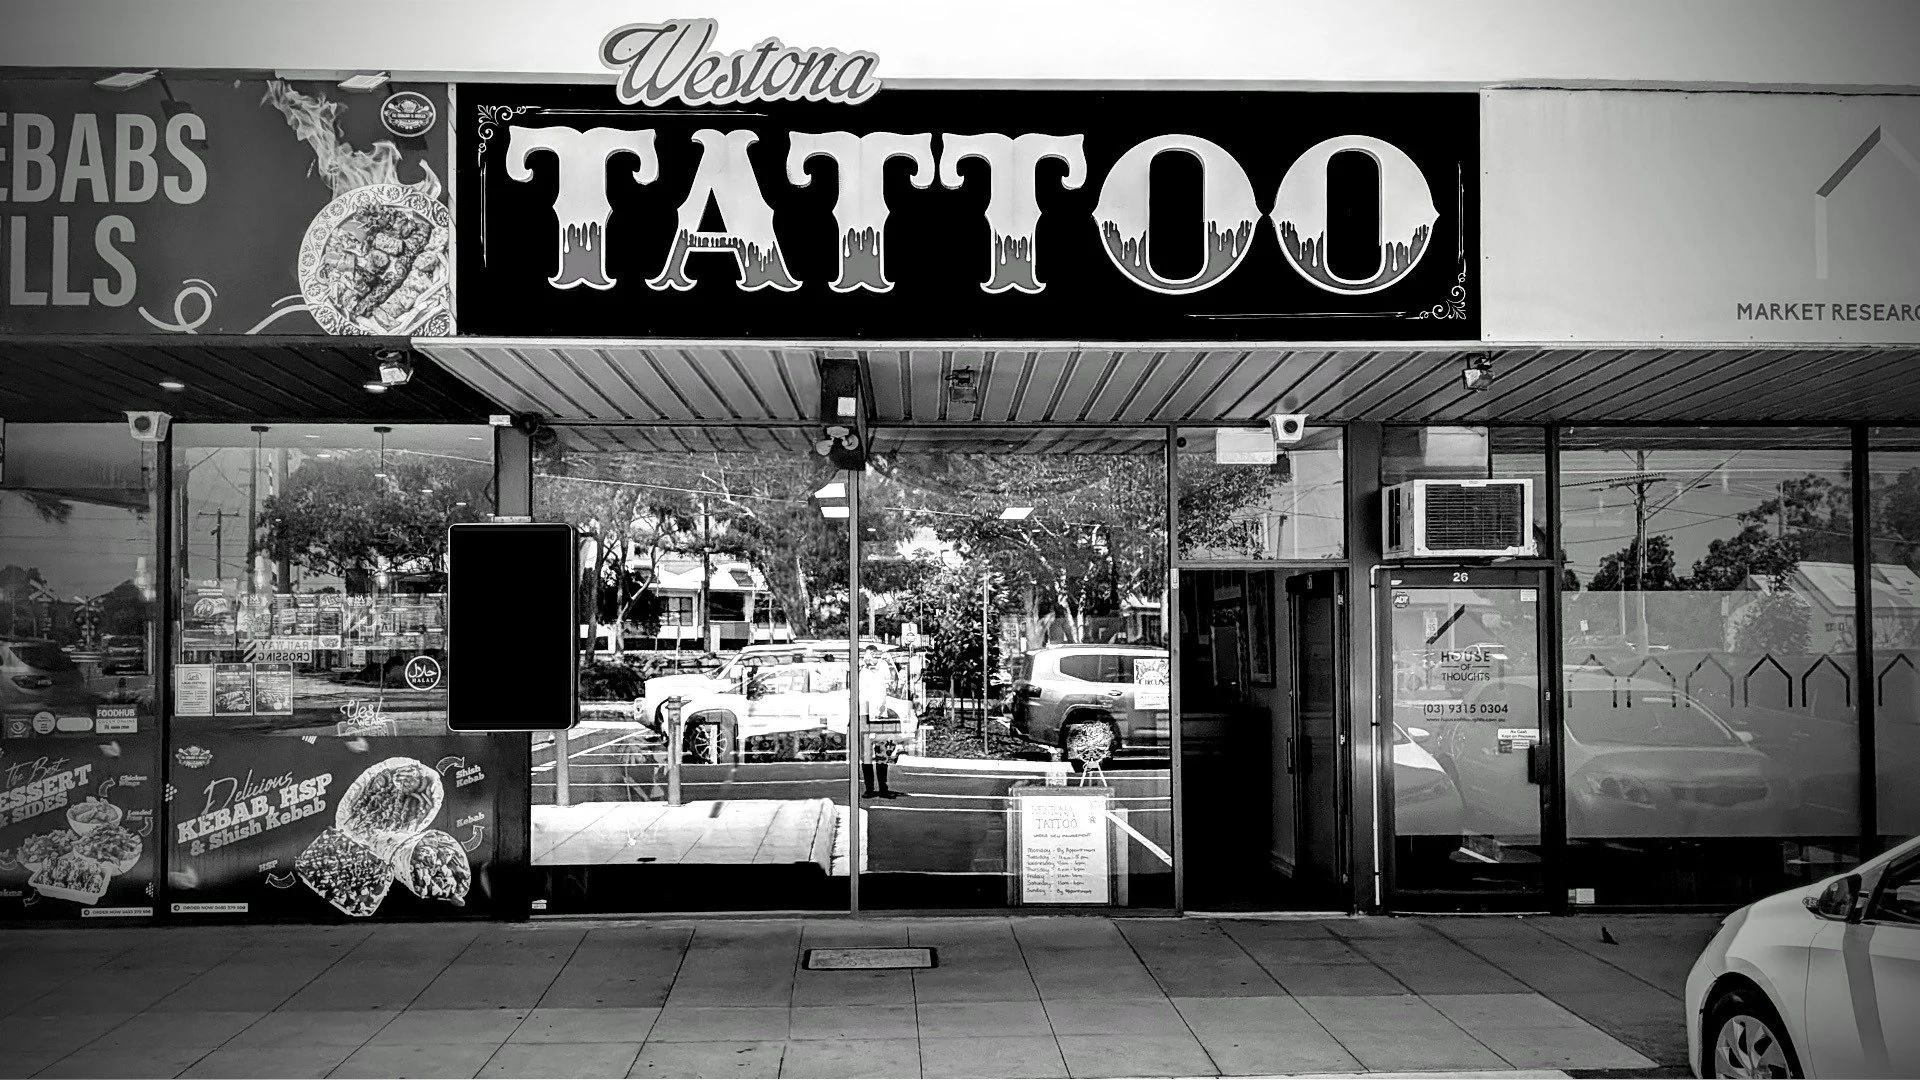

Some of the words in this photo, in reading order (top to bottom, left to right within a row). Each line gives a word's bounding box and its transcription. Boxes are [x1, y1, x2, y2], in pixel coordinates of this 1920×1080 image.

[605, 22, 876, 103] Westona
[0, 113, 207, 204] BABS
[506, 126, 1439, 294] TATTOO
[0, 215, 137, 306] LLS
[1737, 303, 1825, 321] MARKET
[1453, 572, 1469, 582] 26
[1394, 595, 1408, 604] ADT
[1441, 651, 1490, 662] HOUSE
[408, 663, 437, 678] حلال
[1442, 672, 1490, 681] THOUGHTS
[97, 708, 135, 717] FOODHUB
[1423, 704, 1444, 715] (03)
[1448, 704, 1477, 714] 9315
[1480, 703, 1508, 714] 0304
[5, 762, 33, 789] The
[27, 756, 70, 784] Best
[456, 765, 481, 779] Shish
[456, 772, 485, 788] Kebab
[200, 769, 293, 815] Delicious
[12, 791, 68, 823] SIDES
[177, 795, 275, 844] KEBAB,
[279, 773, 333, 809] HSP
[190, 839, 206, 856] &
[209, 819, 263, 850] Shish
[265, 797, 327, 831] Kebab
[456, 811, 485, 828] Kebab
[1035, 818, 1078, 829] TATTOO
[1026, 854, 1050, 862] Tuesday
[259, 860, 278, 873] HSP
[1027, 873, 1045, 881] Friday
